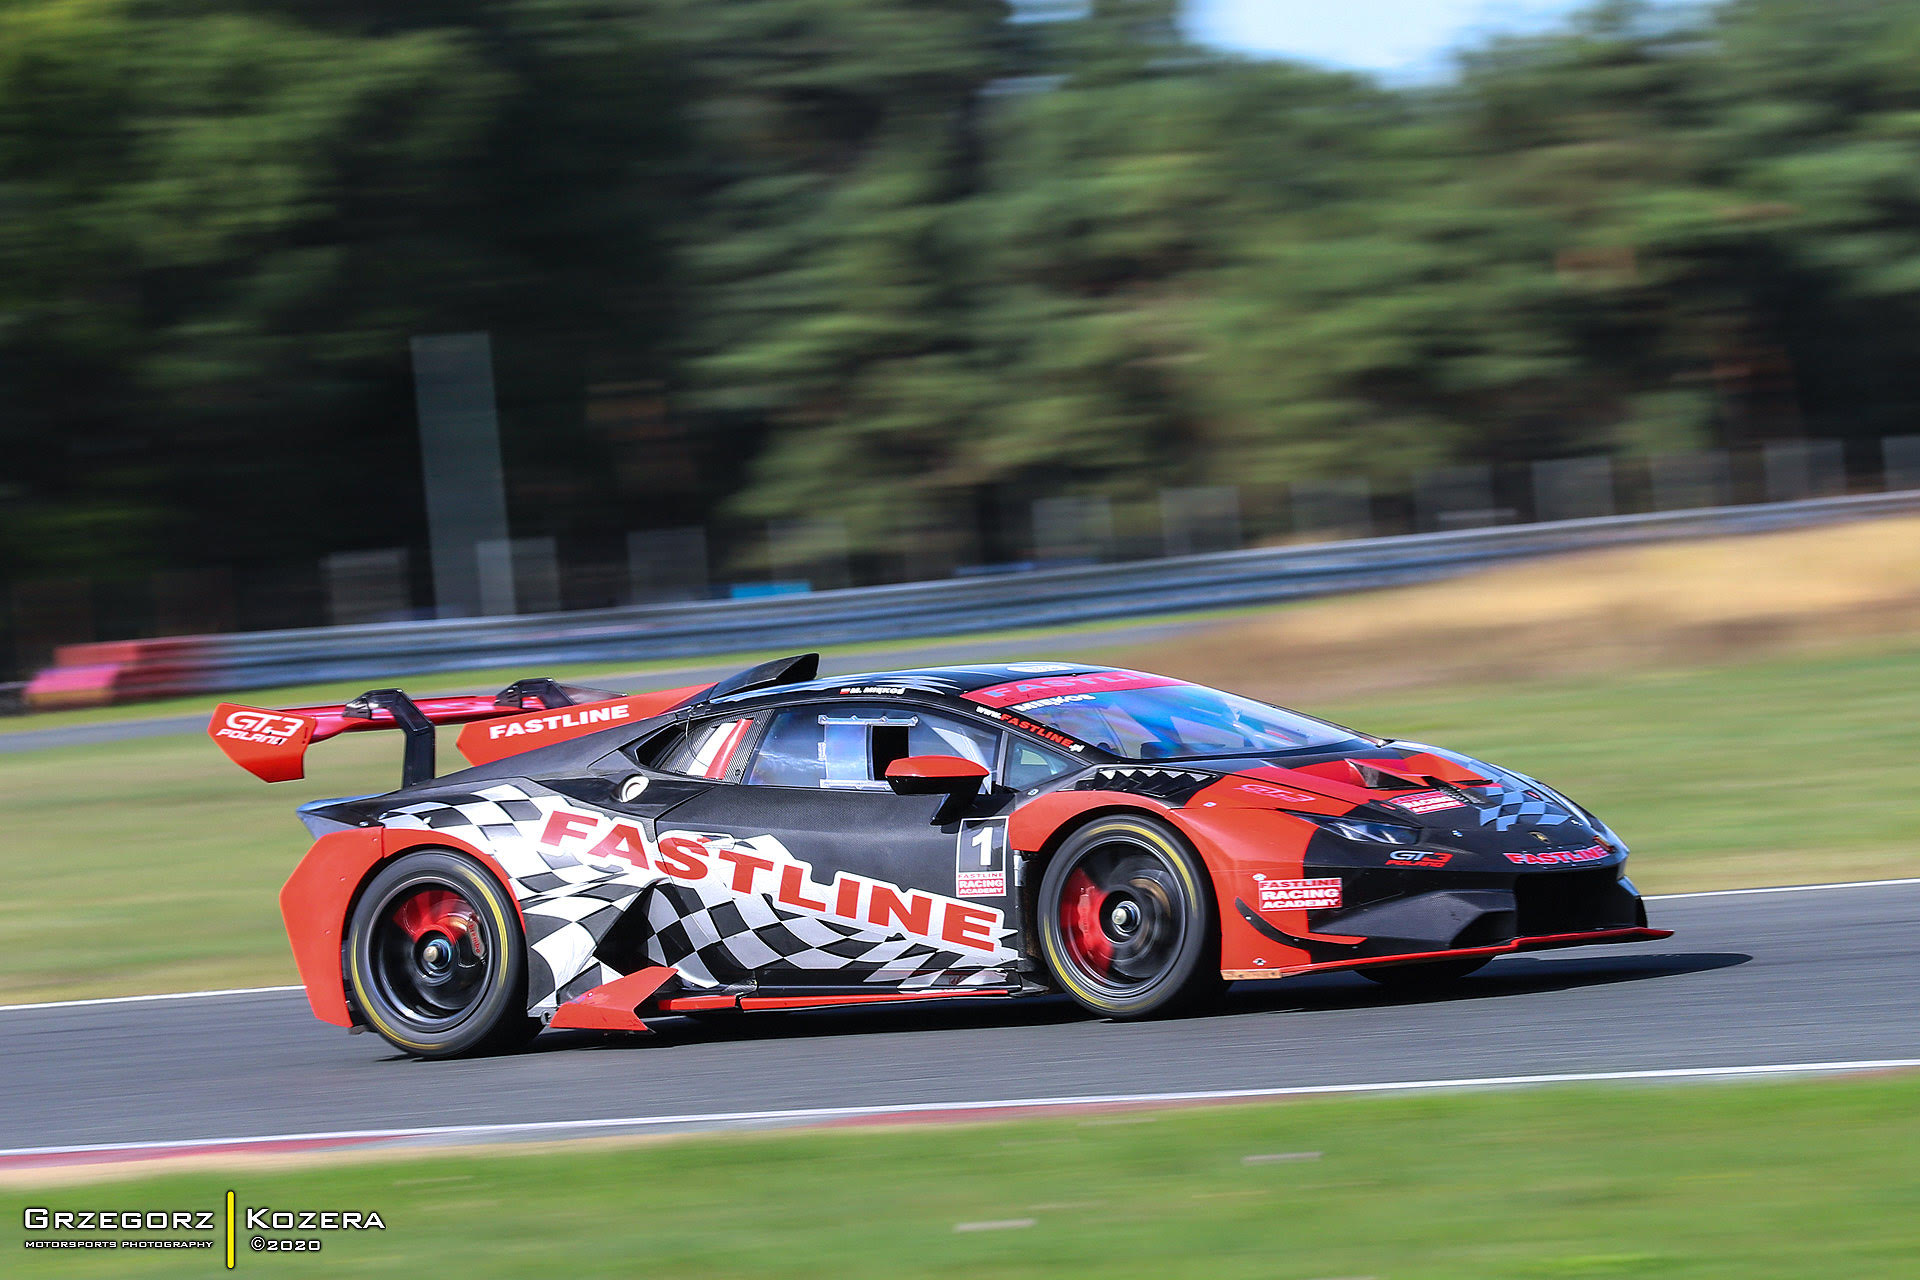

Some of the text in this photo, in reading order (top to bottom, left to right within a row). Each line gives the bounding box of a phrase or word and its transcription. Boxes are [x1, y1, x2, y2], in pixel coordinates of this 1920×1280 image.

[226, 711, 304, 737] GT3
[489, 704, 629, 740] FASTLINE
[971, 827, 993, 866] 1
[1389, 850, 1453, 862] GT3
[1503, 845, 1611, 865] FASTLINE
[539, 810, 999, 952] FASTLINE
[959, 880, 1003, 888] RACING
[1260, 880, 1341, 888] FASTLINE
[1261, 889, 1340, 900] RACING
[1262, 899, 1340, 909] ACADEMY
